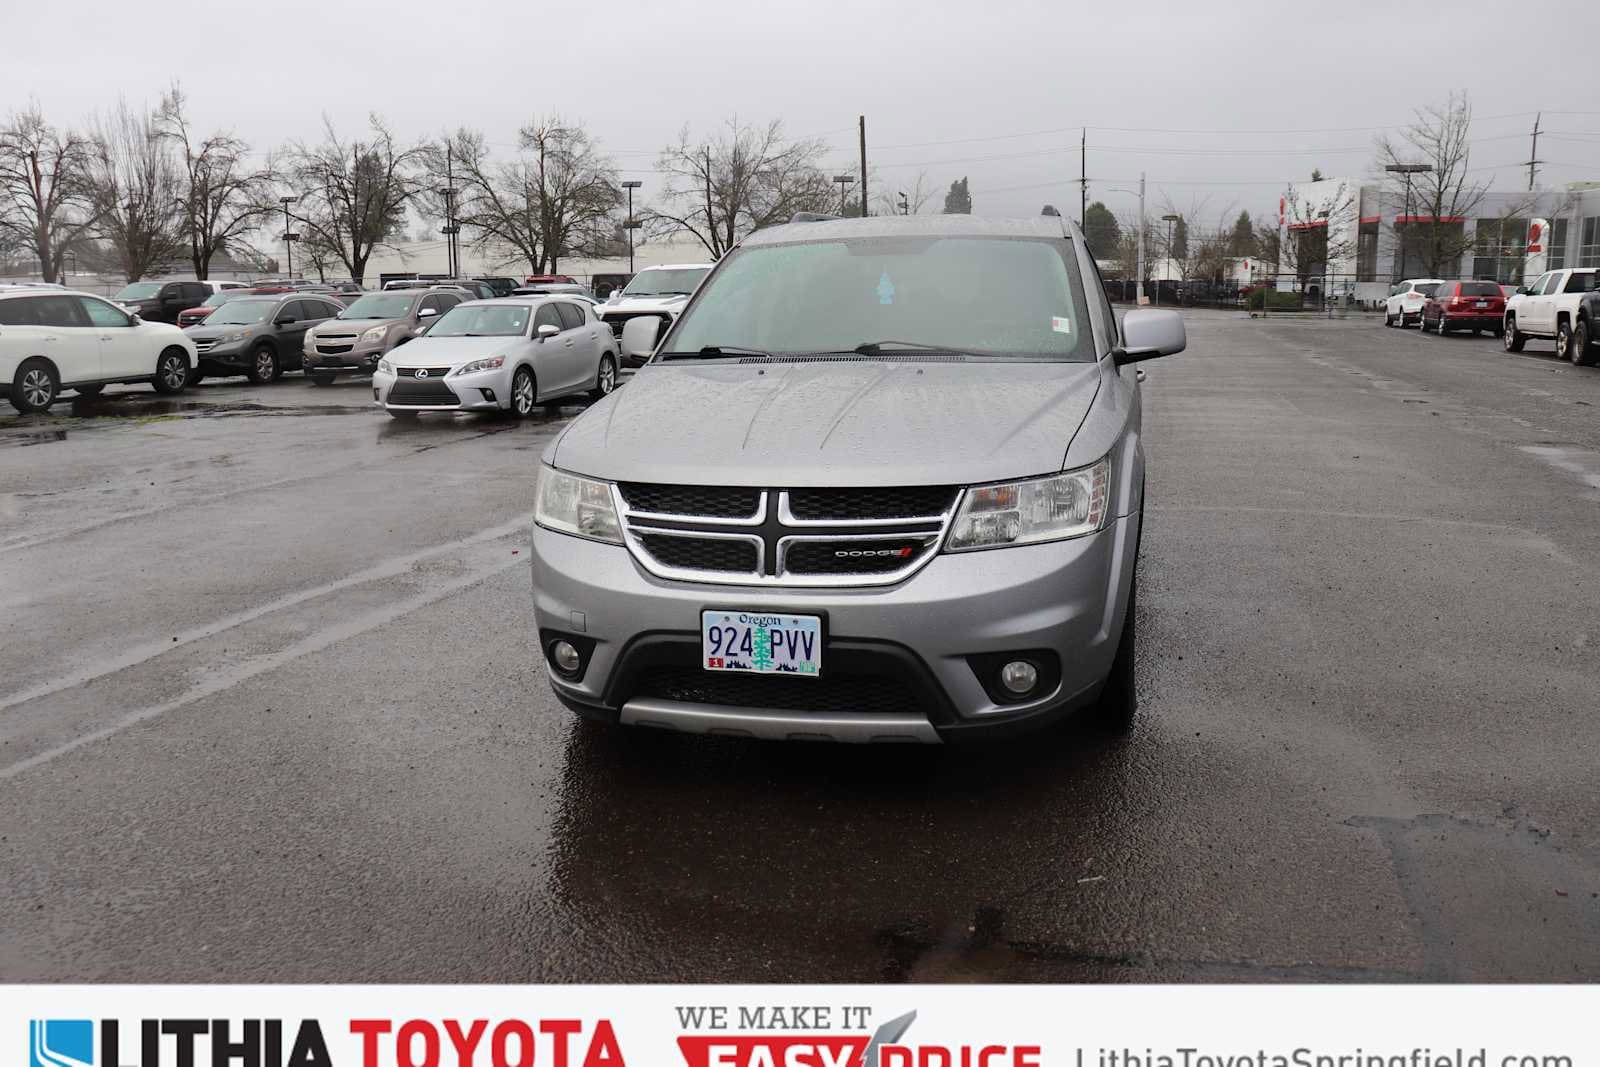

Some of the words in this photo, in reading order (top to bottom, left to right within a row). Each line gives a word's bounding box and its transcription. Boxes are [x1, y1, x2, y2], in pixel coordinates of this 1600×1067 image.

[835, 549, 905, 558] DODGE
[739, 614, 782, 627] Oregon
[709, 626, 753, 657] 924
[770, 629, 815, 661] PVV
